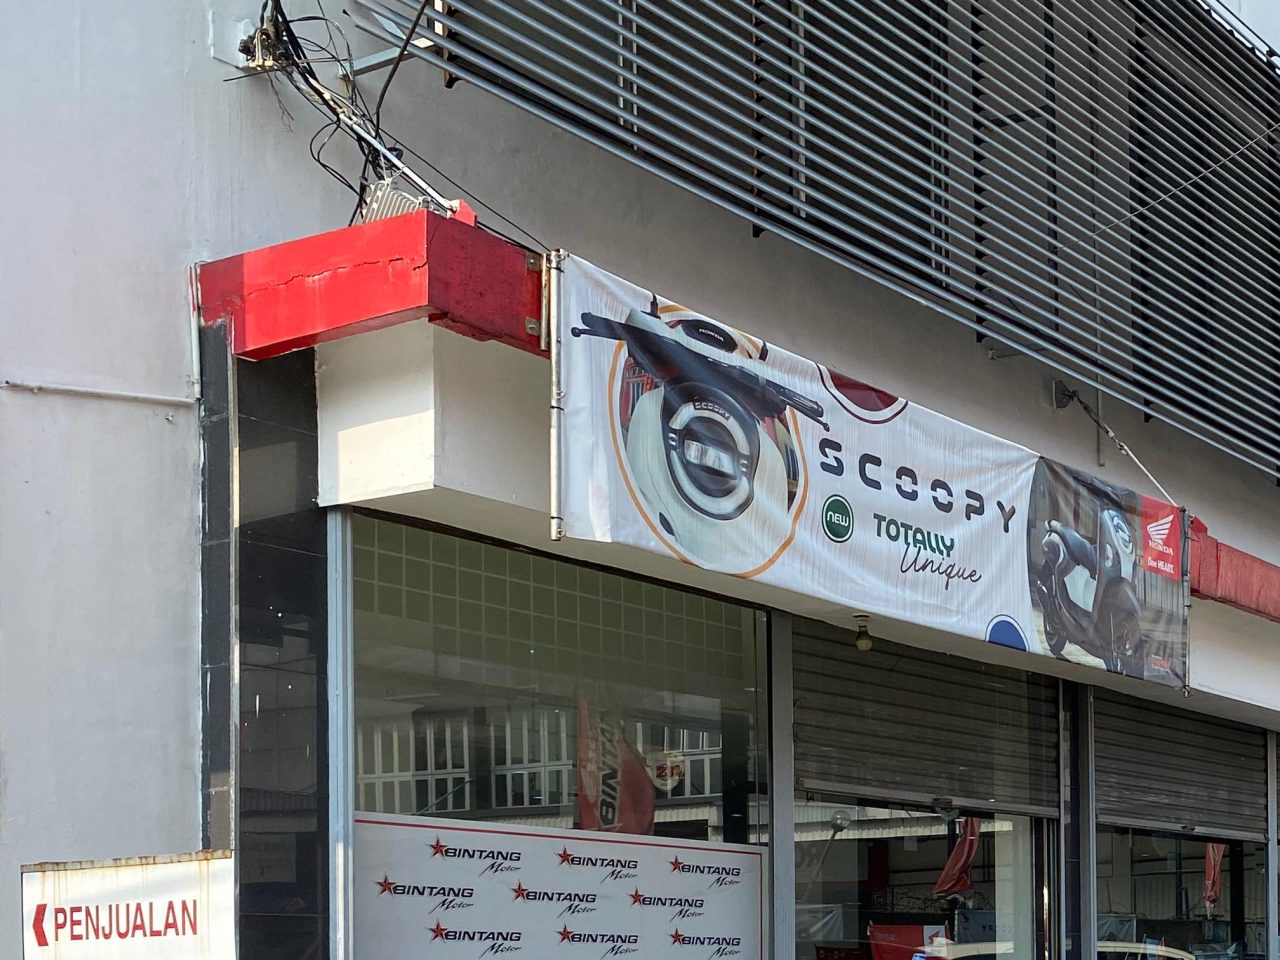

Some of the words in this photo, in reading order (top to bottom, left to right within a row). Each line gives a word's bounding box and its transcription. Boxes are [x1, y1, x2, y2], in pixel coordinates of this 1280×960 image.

[819, 437, 1016, 533] SCOOPY
[827, 511, 849, 527] NEW
[873, 513, 955, 557] TOTALLY
[1149, 540, 1174, 556] HONDA
[900, 543, 982, 590] Unique
[444, 847, 521, 861] BINTANG
[479, 861, 521, 877] Motor
[570, 856, 638, 869] BINTANG
[601, 868, 638, 883] Motor
[680, 864, 740, 877] BINTANG
[709, 875, 740, 889] Motor
[393, 884, 473, 897] BINTANG
[525, 891, 596, 903] BINTANG
[429, 898, 474, 914] Motor
[642, 896, 704, 908] BINTANG
[558, 902, 596, 918] Motor
[671, 908, 704, 922] Motor
[54, 899, 198, 941] PENJUALAN
[445, 931, 521, 941] BINTANG
[570, 933, 638, 943] BINTANG
[681, 936, 740, 946] BINTANG
[480, 942, 522, 958] Motor
[601, 944, 638, 959] Motor
[708, 945, 740, 960] Motor
